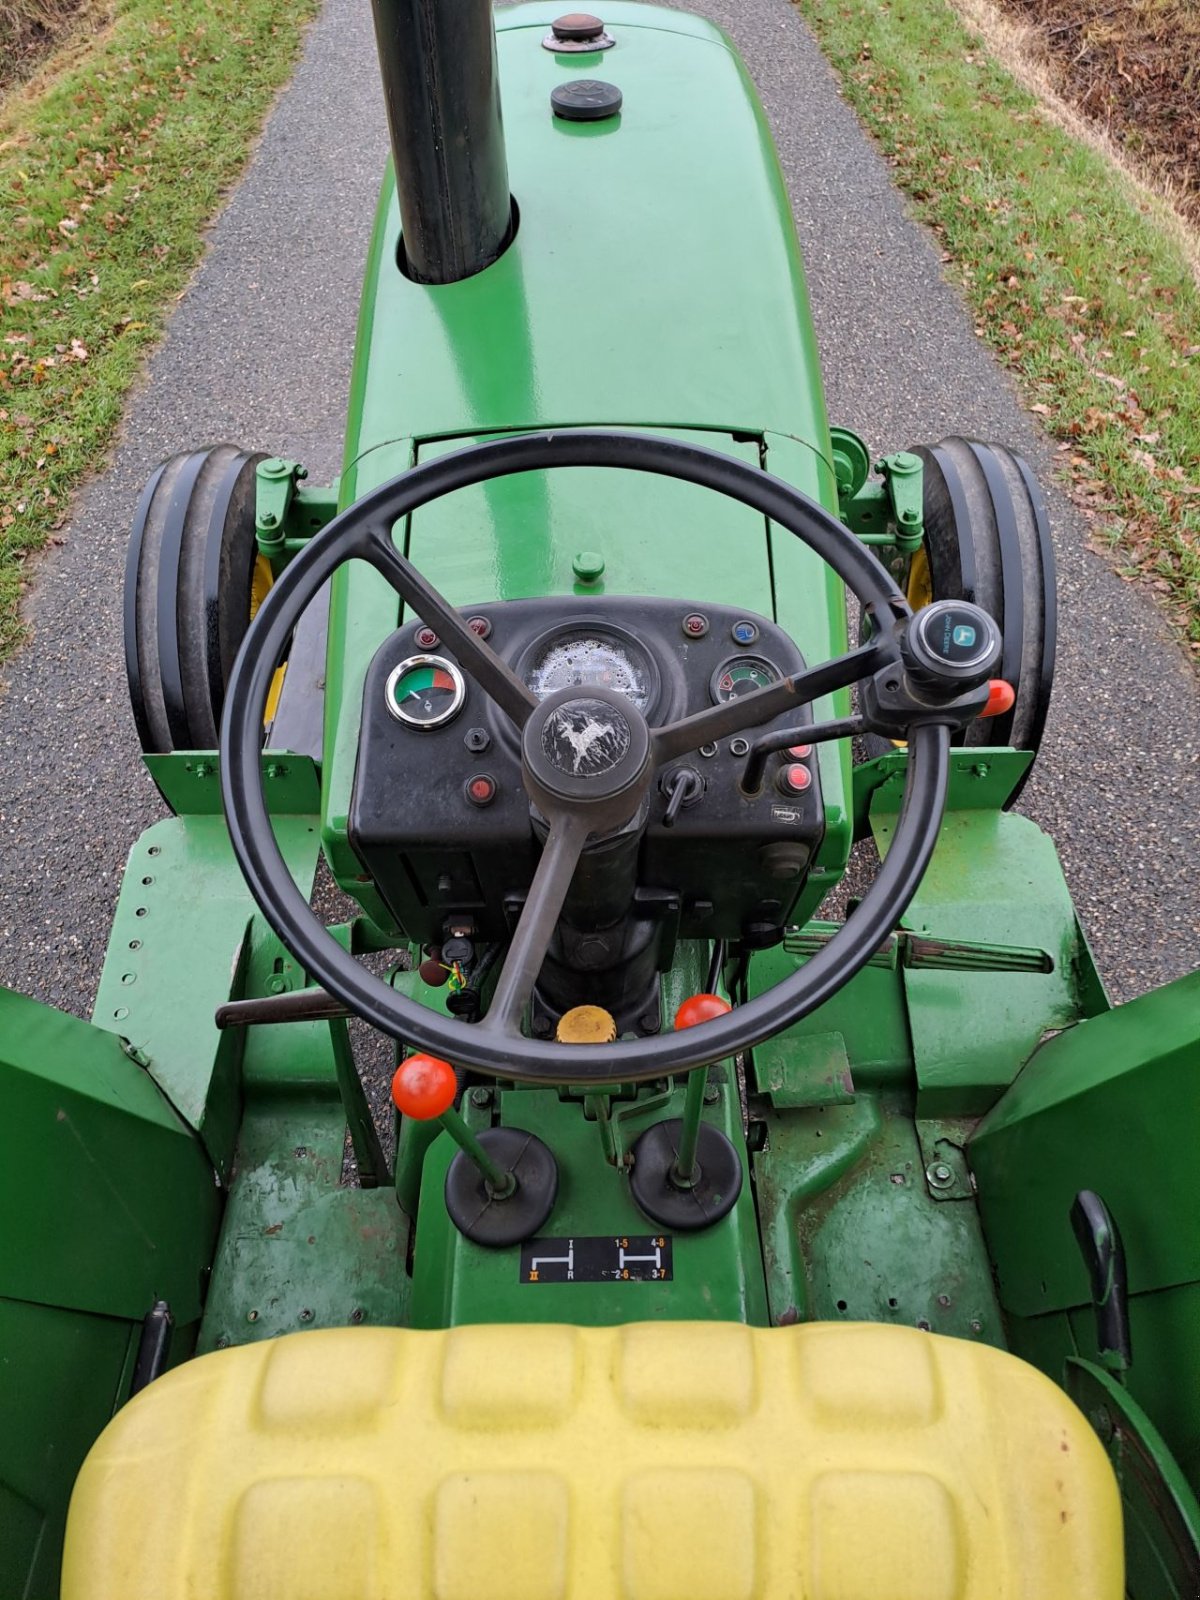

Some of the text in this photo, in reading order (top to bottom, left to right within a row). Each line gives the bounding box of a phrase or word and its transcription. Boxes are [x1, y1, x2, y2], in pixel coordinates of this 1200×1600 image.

[614, 1239, 629, 1248] 1-5
[567, 1270, 574, 1280] R
[651, 1269, 666, 1279] 3-7
